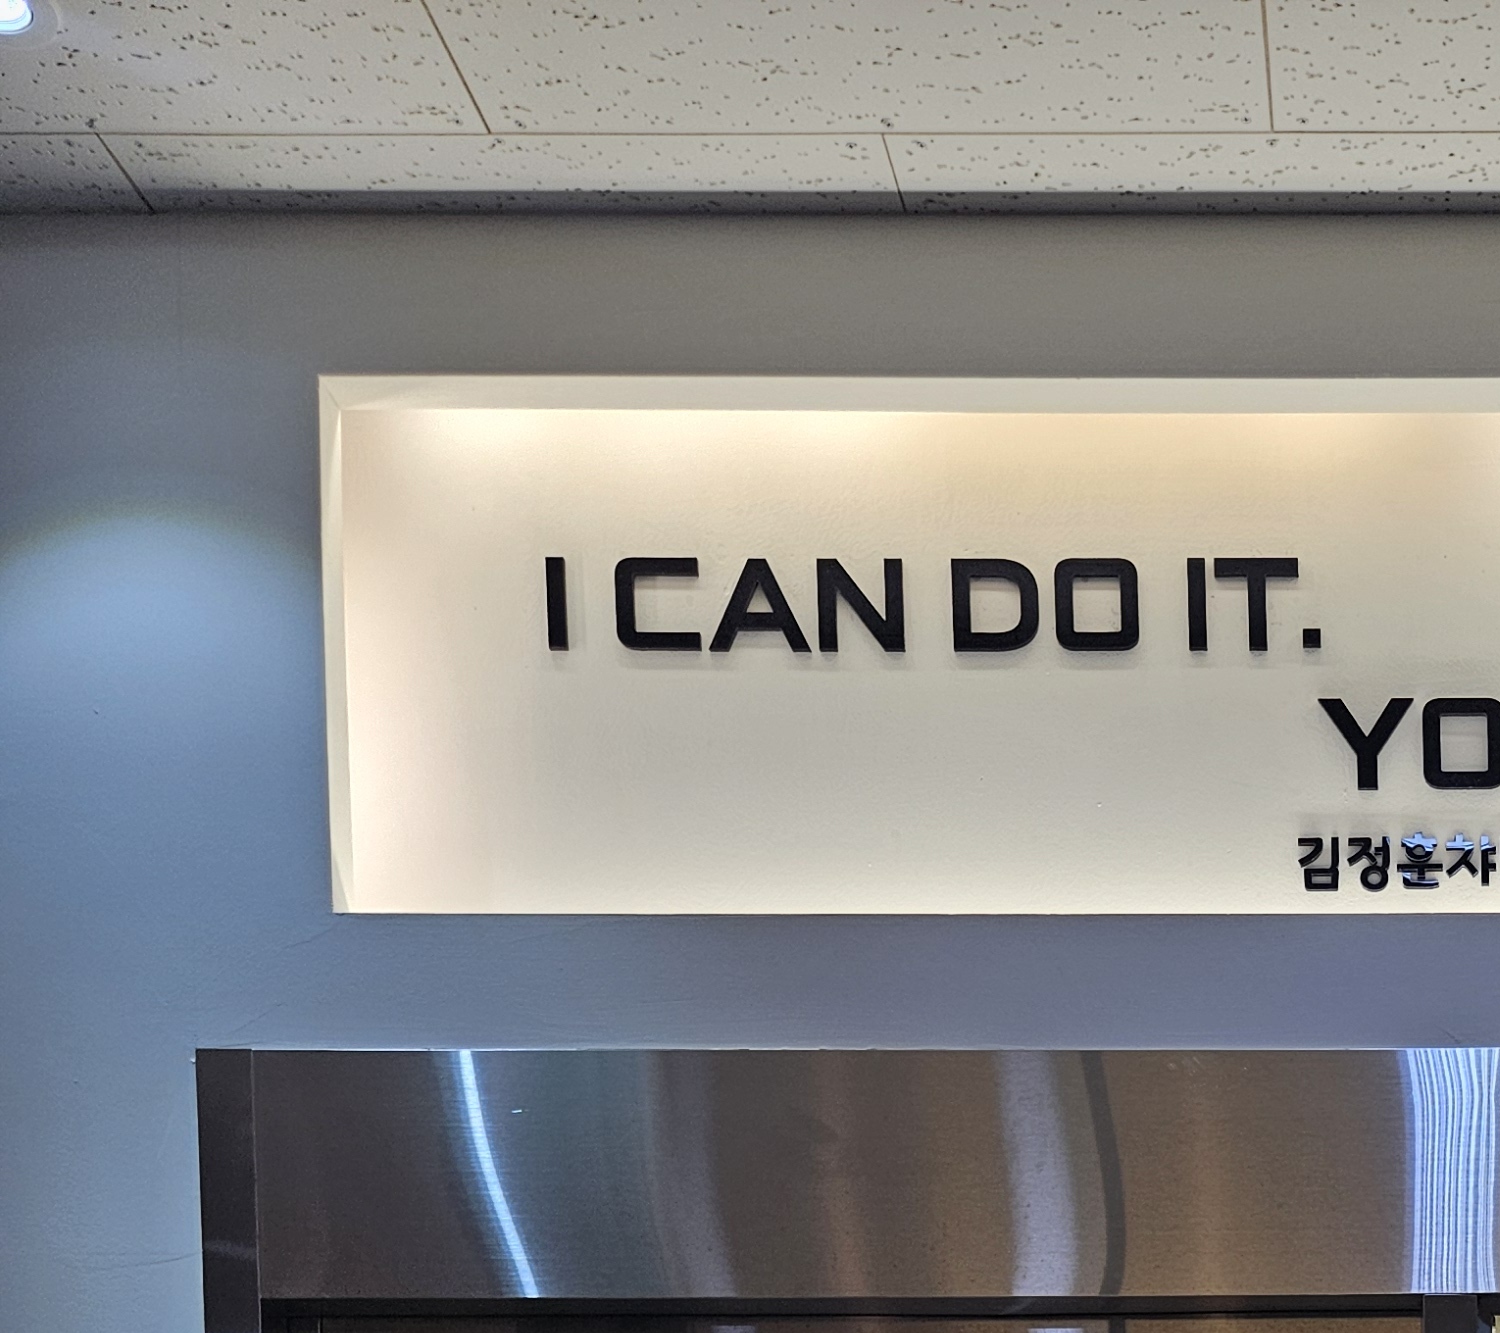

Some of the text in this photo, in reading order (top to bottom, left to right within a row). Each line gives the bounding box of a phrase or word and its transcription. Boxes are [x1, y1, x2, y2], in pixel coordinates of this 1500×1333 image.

[545, 556, 1322, 653] I CAN DO IT.
